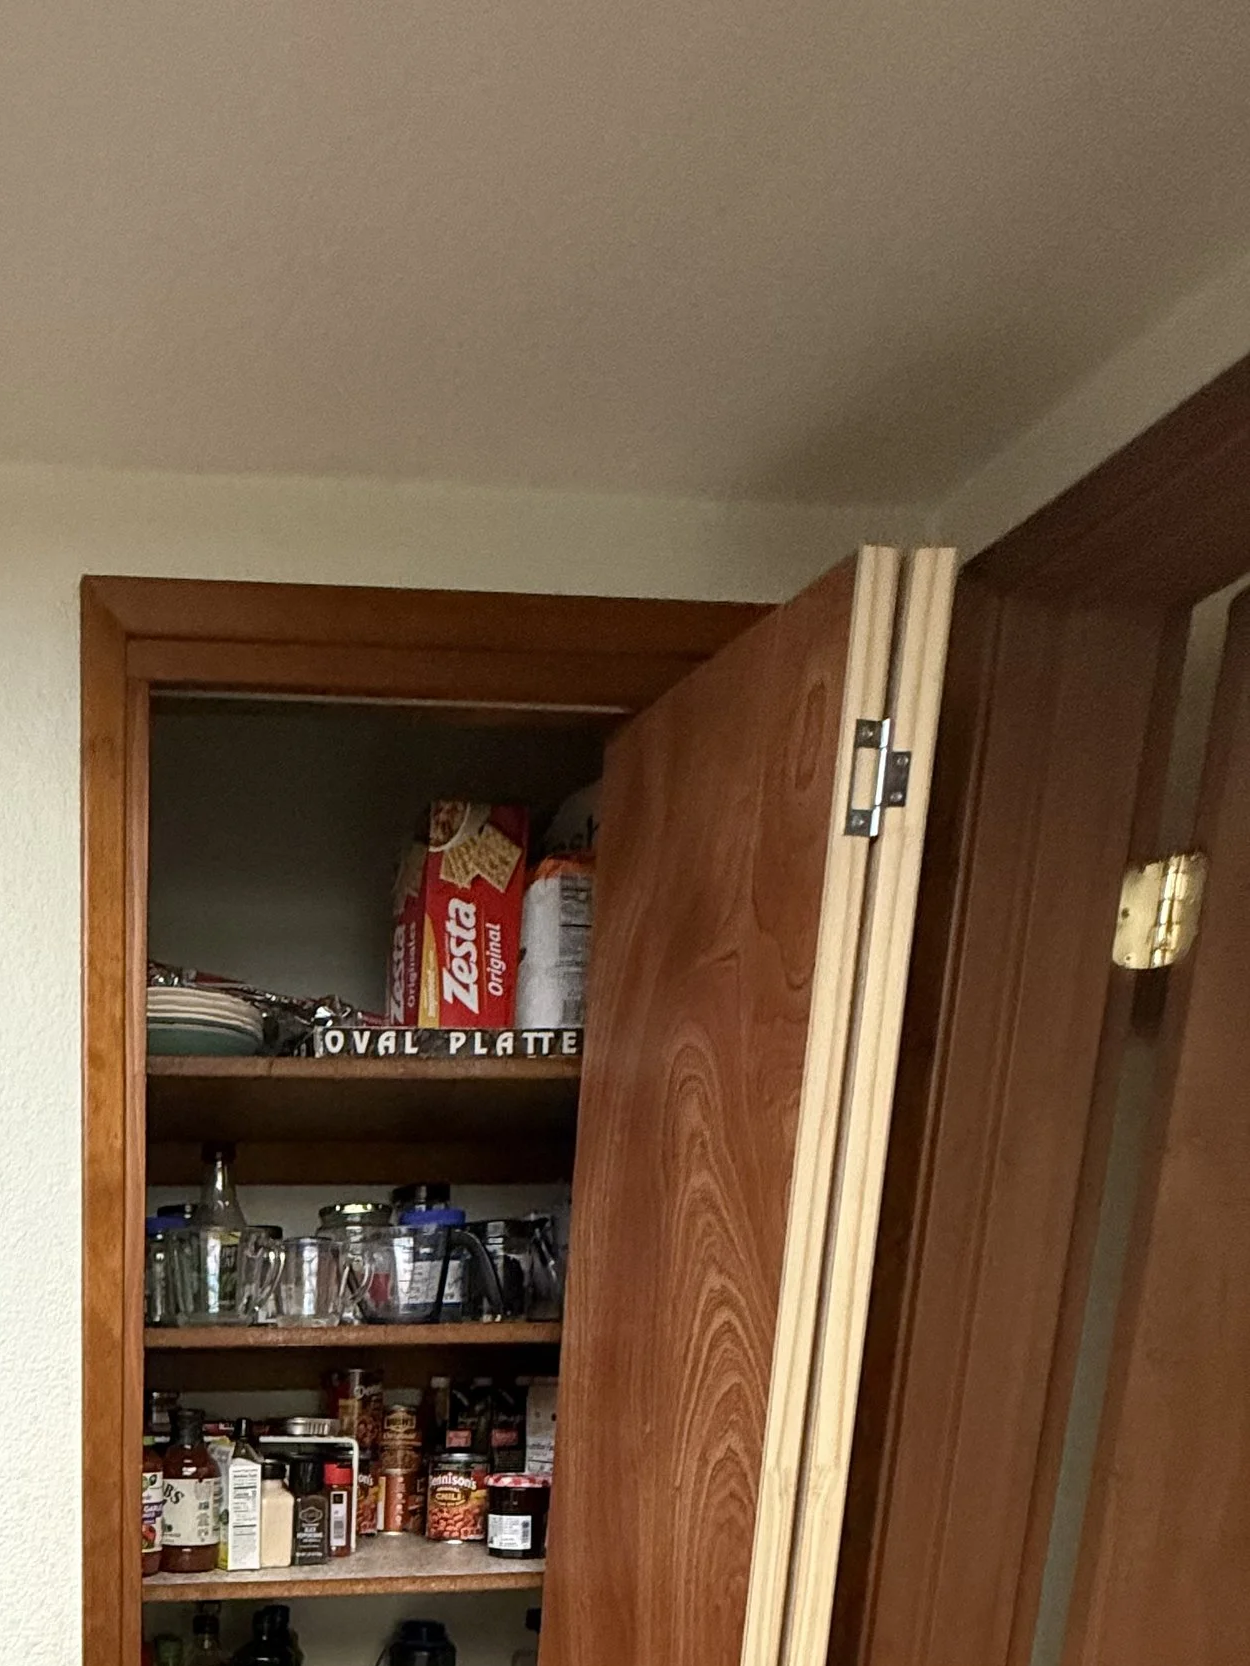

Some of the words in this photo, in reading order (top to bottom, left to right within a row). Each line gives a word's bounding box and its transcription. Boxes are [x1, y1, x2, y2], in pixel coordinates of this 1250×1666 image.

[390, 925, 406, 1025] Zesta
[442, 897, 479, 1014] Zesta
[486, 923, 506, 997] Original
[325, 1030, 418, 1056] OVAL
[450, 1031, 578, 1056] PLATTE
